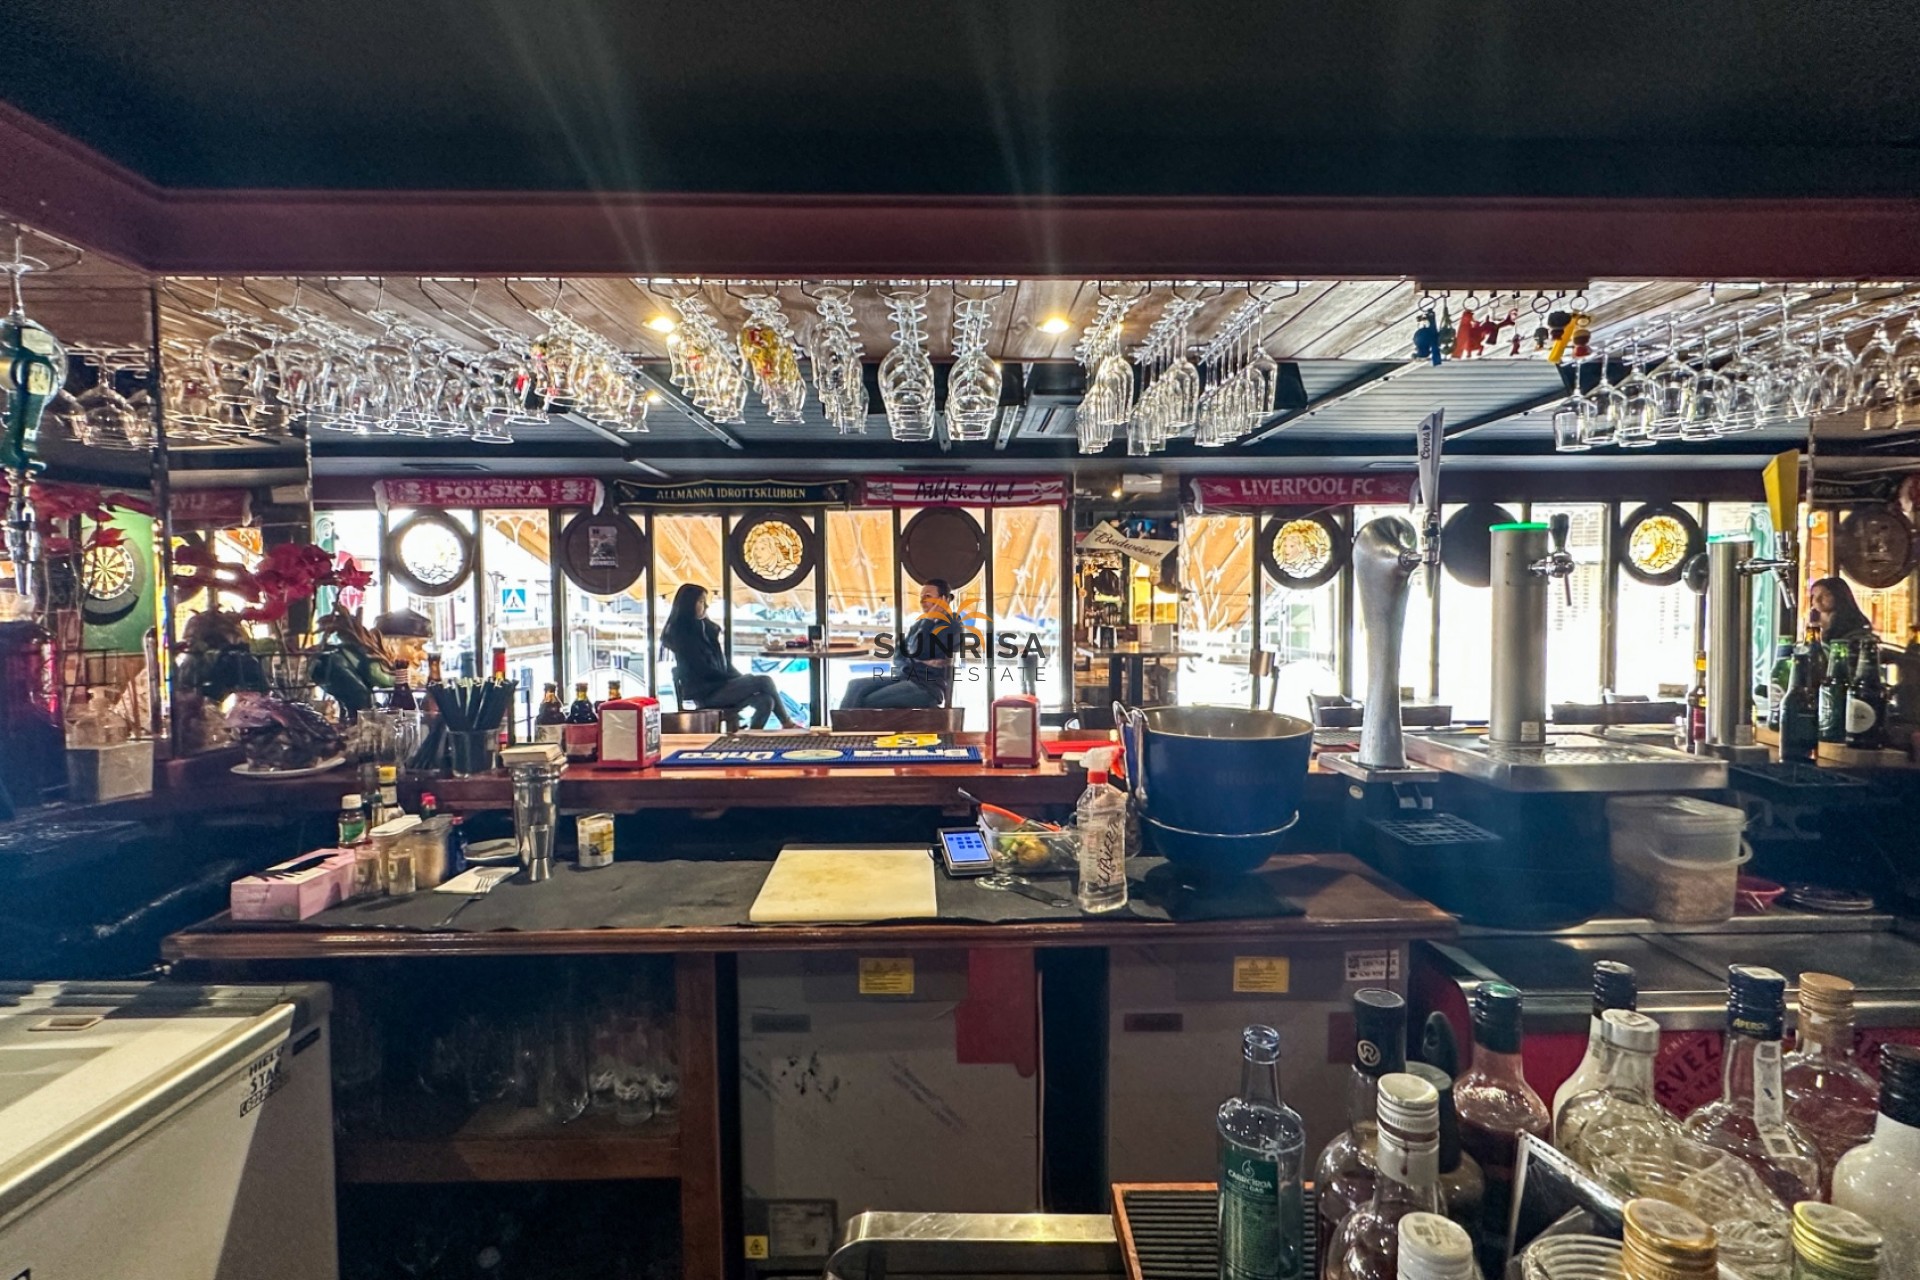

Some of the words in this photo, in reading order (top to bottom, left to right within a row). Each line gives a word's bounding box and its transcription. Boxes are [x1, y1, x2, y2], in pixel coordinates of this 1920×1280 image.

[1420, 432, 1431, 461] Coors
[435, 484, 548, 499] POLSKA
[716, 487, 806, 499] IDROTTSKLUBBEN
[914, 477, 976, 502] Athletic
[979, 480, 1017, 502] Club
[1240, 478, 1348, 496] LIVERPOOL
[1351, 478, 1376, 496] FC
[1093, 529, 1164, 557] Budweiser
[853, 748, 970, 758] Branca
